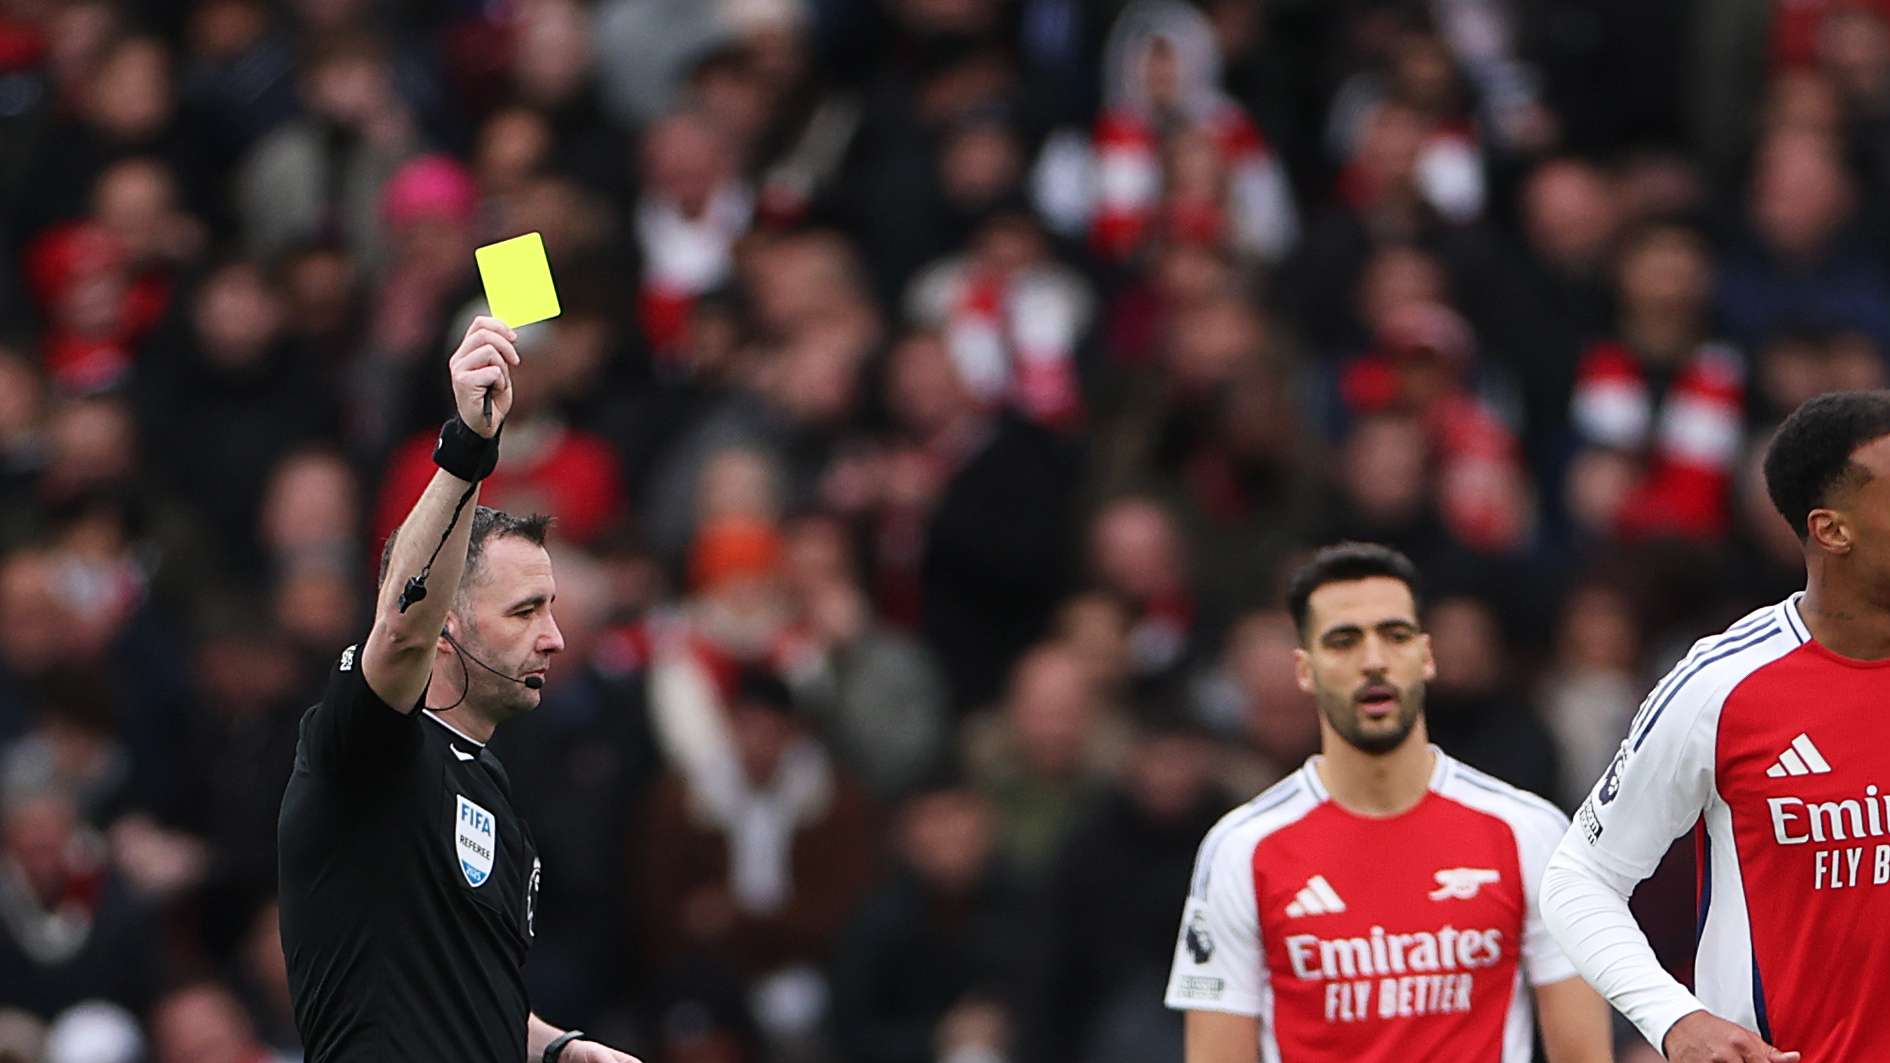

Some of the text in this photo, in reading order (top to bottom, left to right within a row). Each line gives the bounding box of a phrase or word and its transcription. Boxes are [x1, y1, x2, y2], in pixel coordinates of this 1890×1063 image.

[461, 803, 491, 837] FIFA
[459, 835, 491, 861] REFEREE
[1815, 848, 1863, 890] FLY
[1285, 925, 1503, 981] Emirates
[1325, 972, 1474, 1023] FLY BETTER
